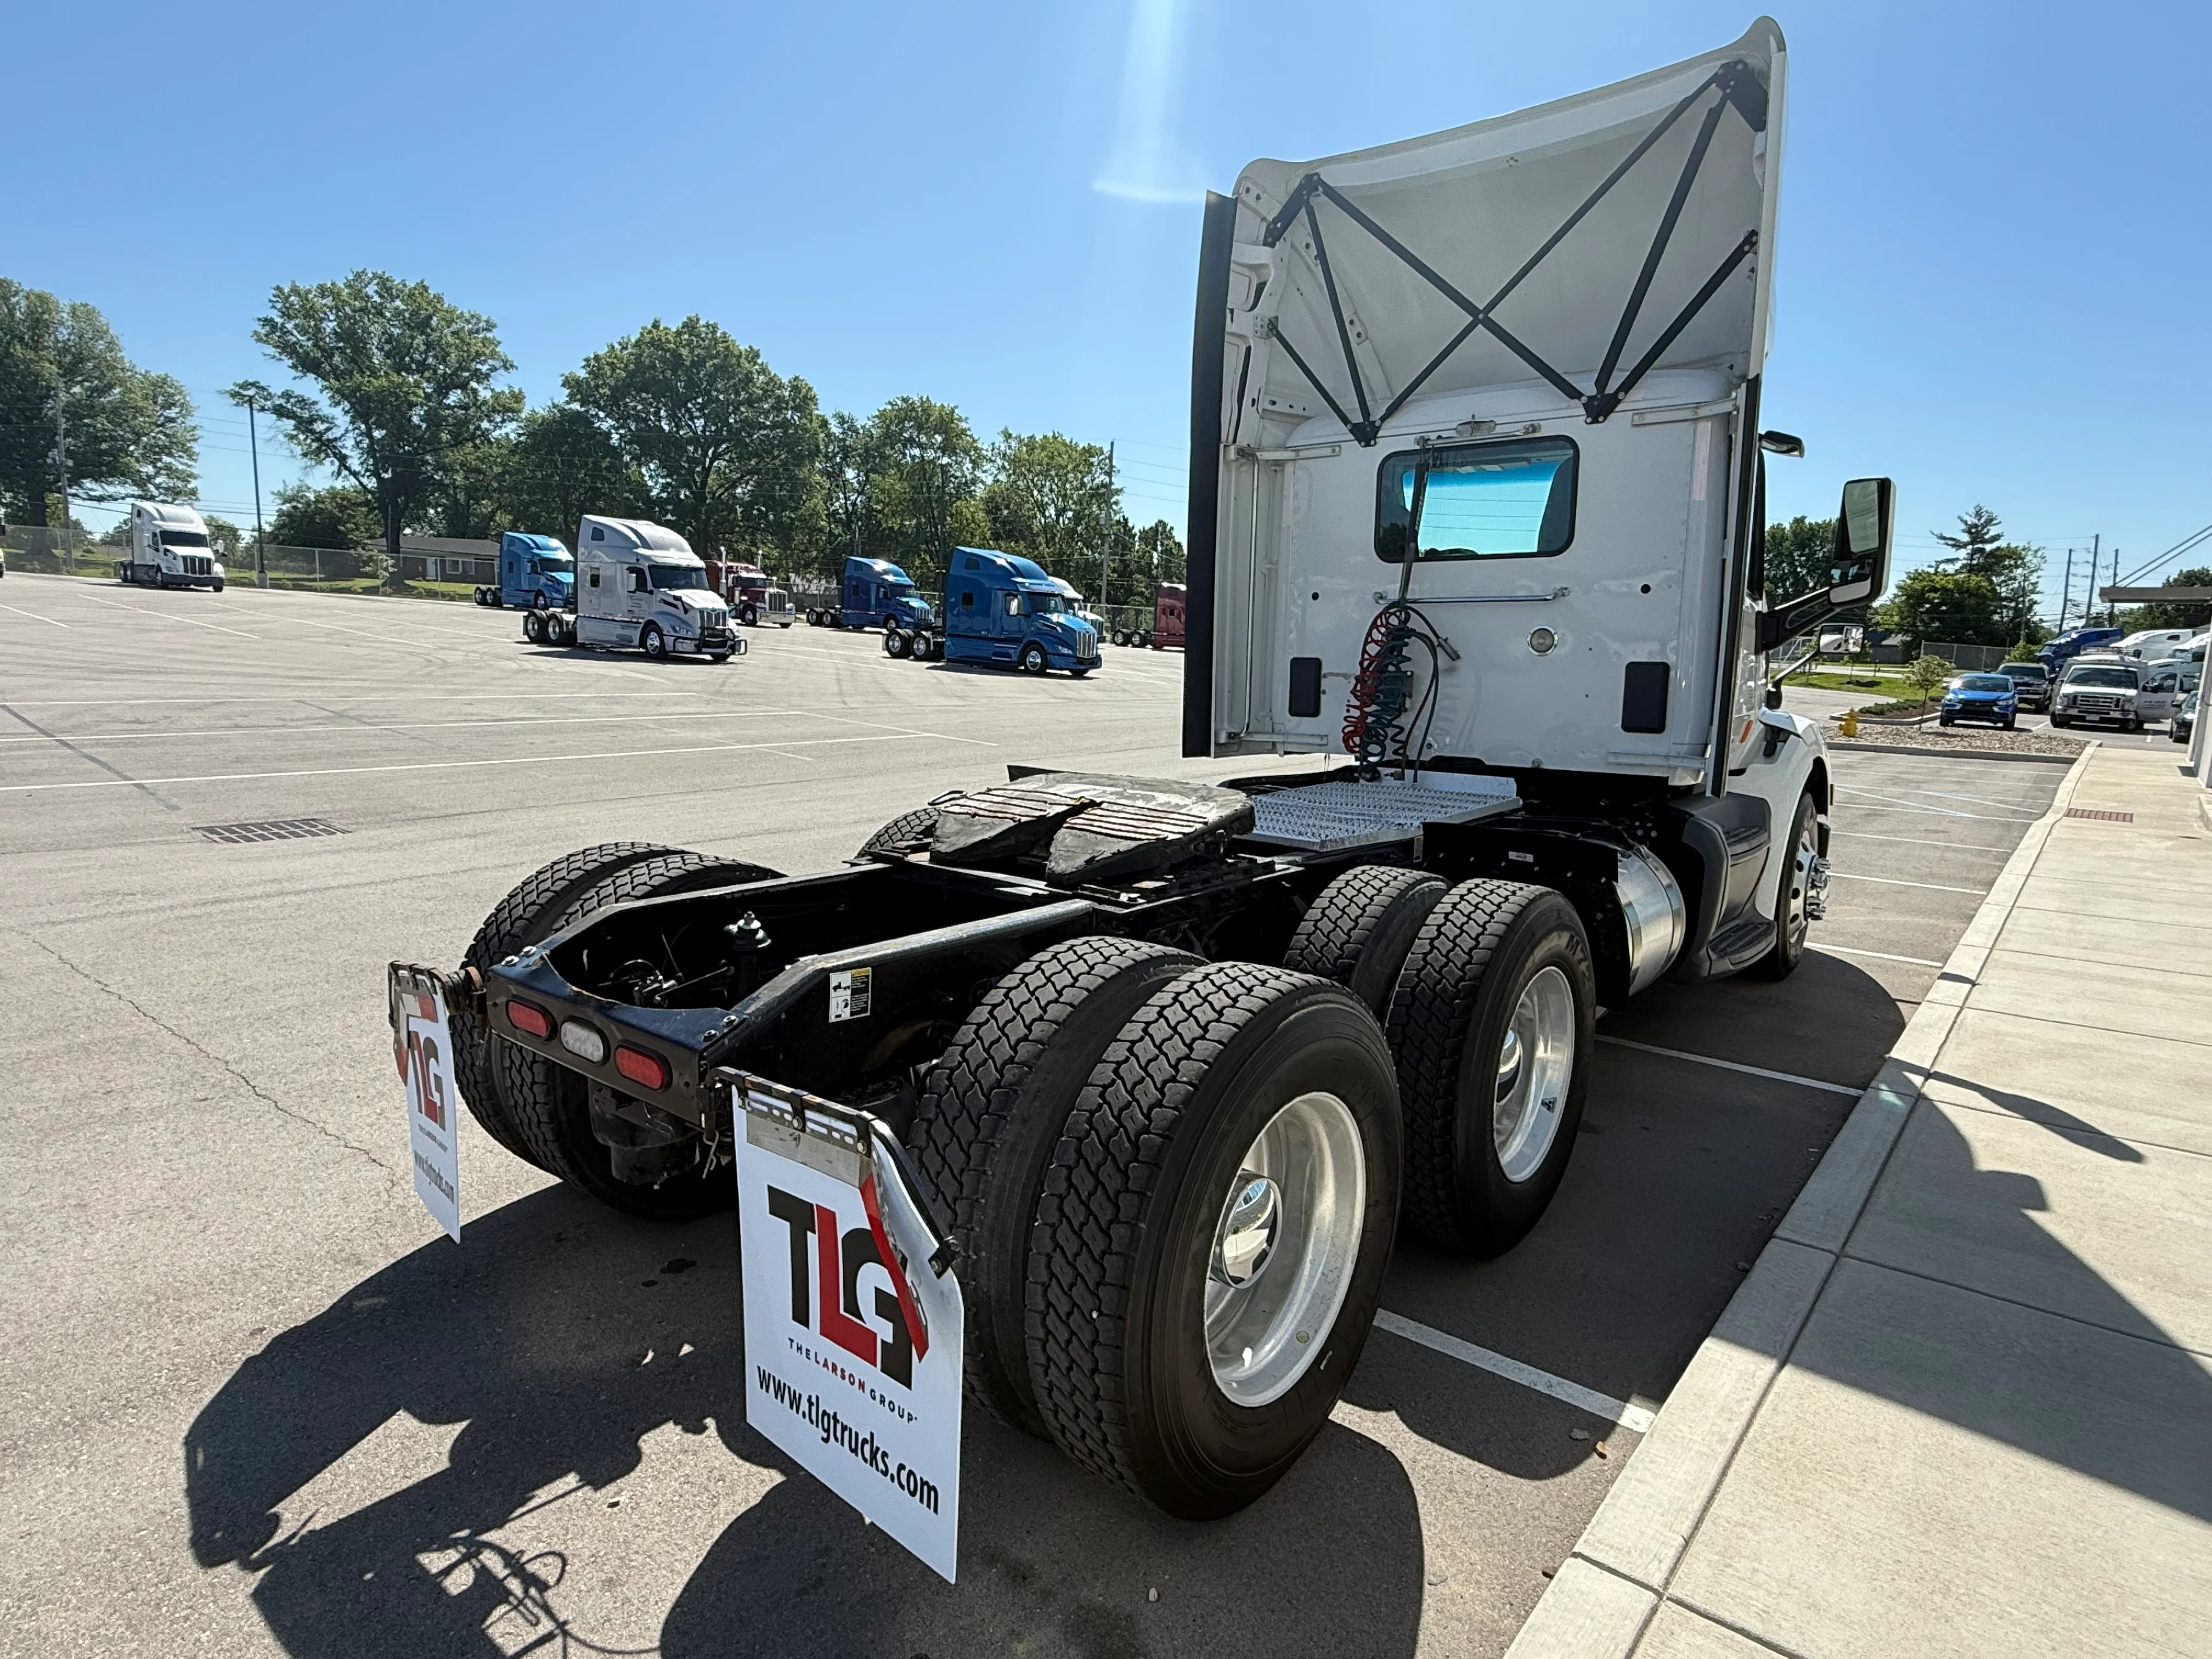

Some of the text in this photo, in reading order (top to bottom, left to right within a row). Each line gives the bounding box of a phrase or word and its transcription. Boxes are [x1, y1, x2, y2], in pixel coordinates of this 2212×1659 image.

[767, 1184, 912, 1391] TLG
[757, 1364, 939, 1516] www.tlgtrucks.com
[788, 1337, 913, 1424] THE LARSON GROUP
